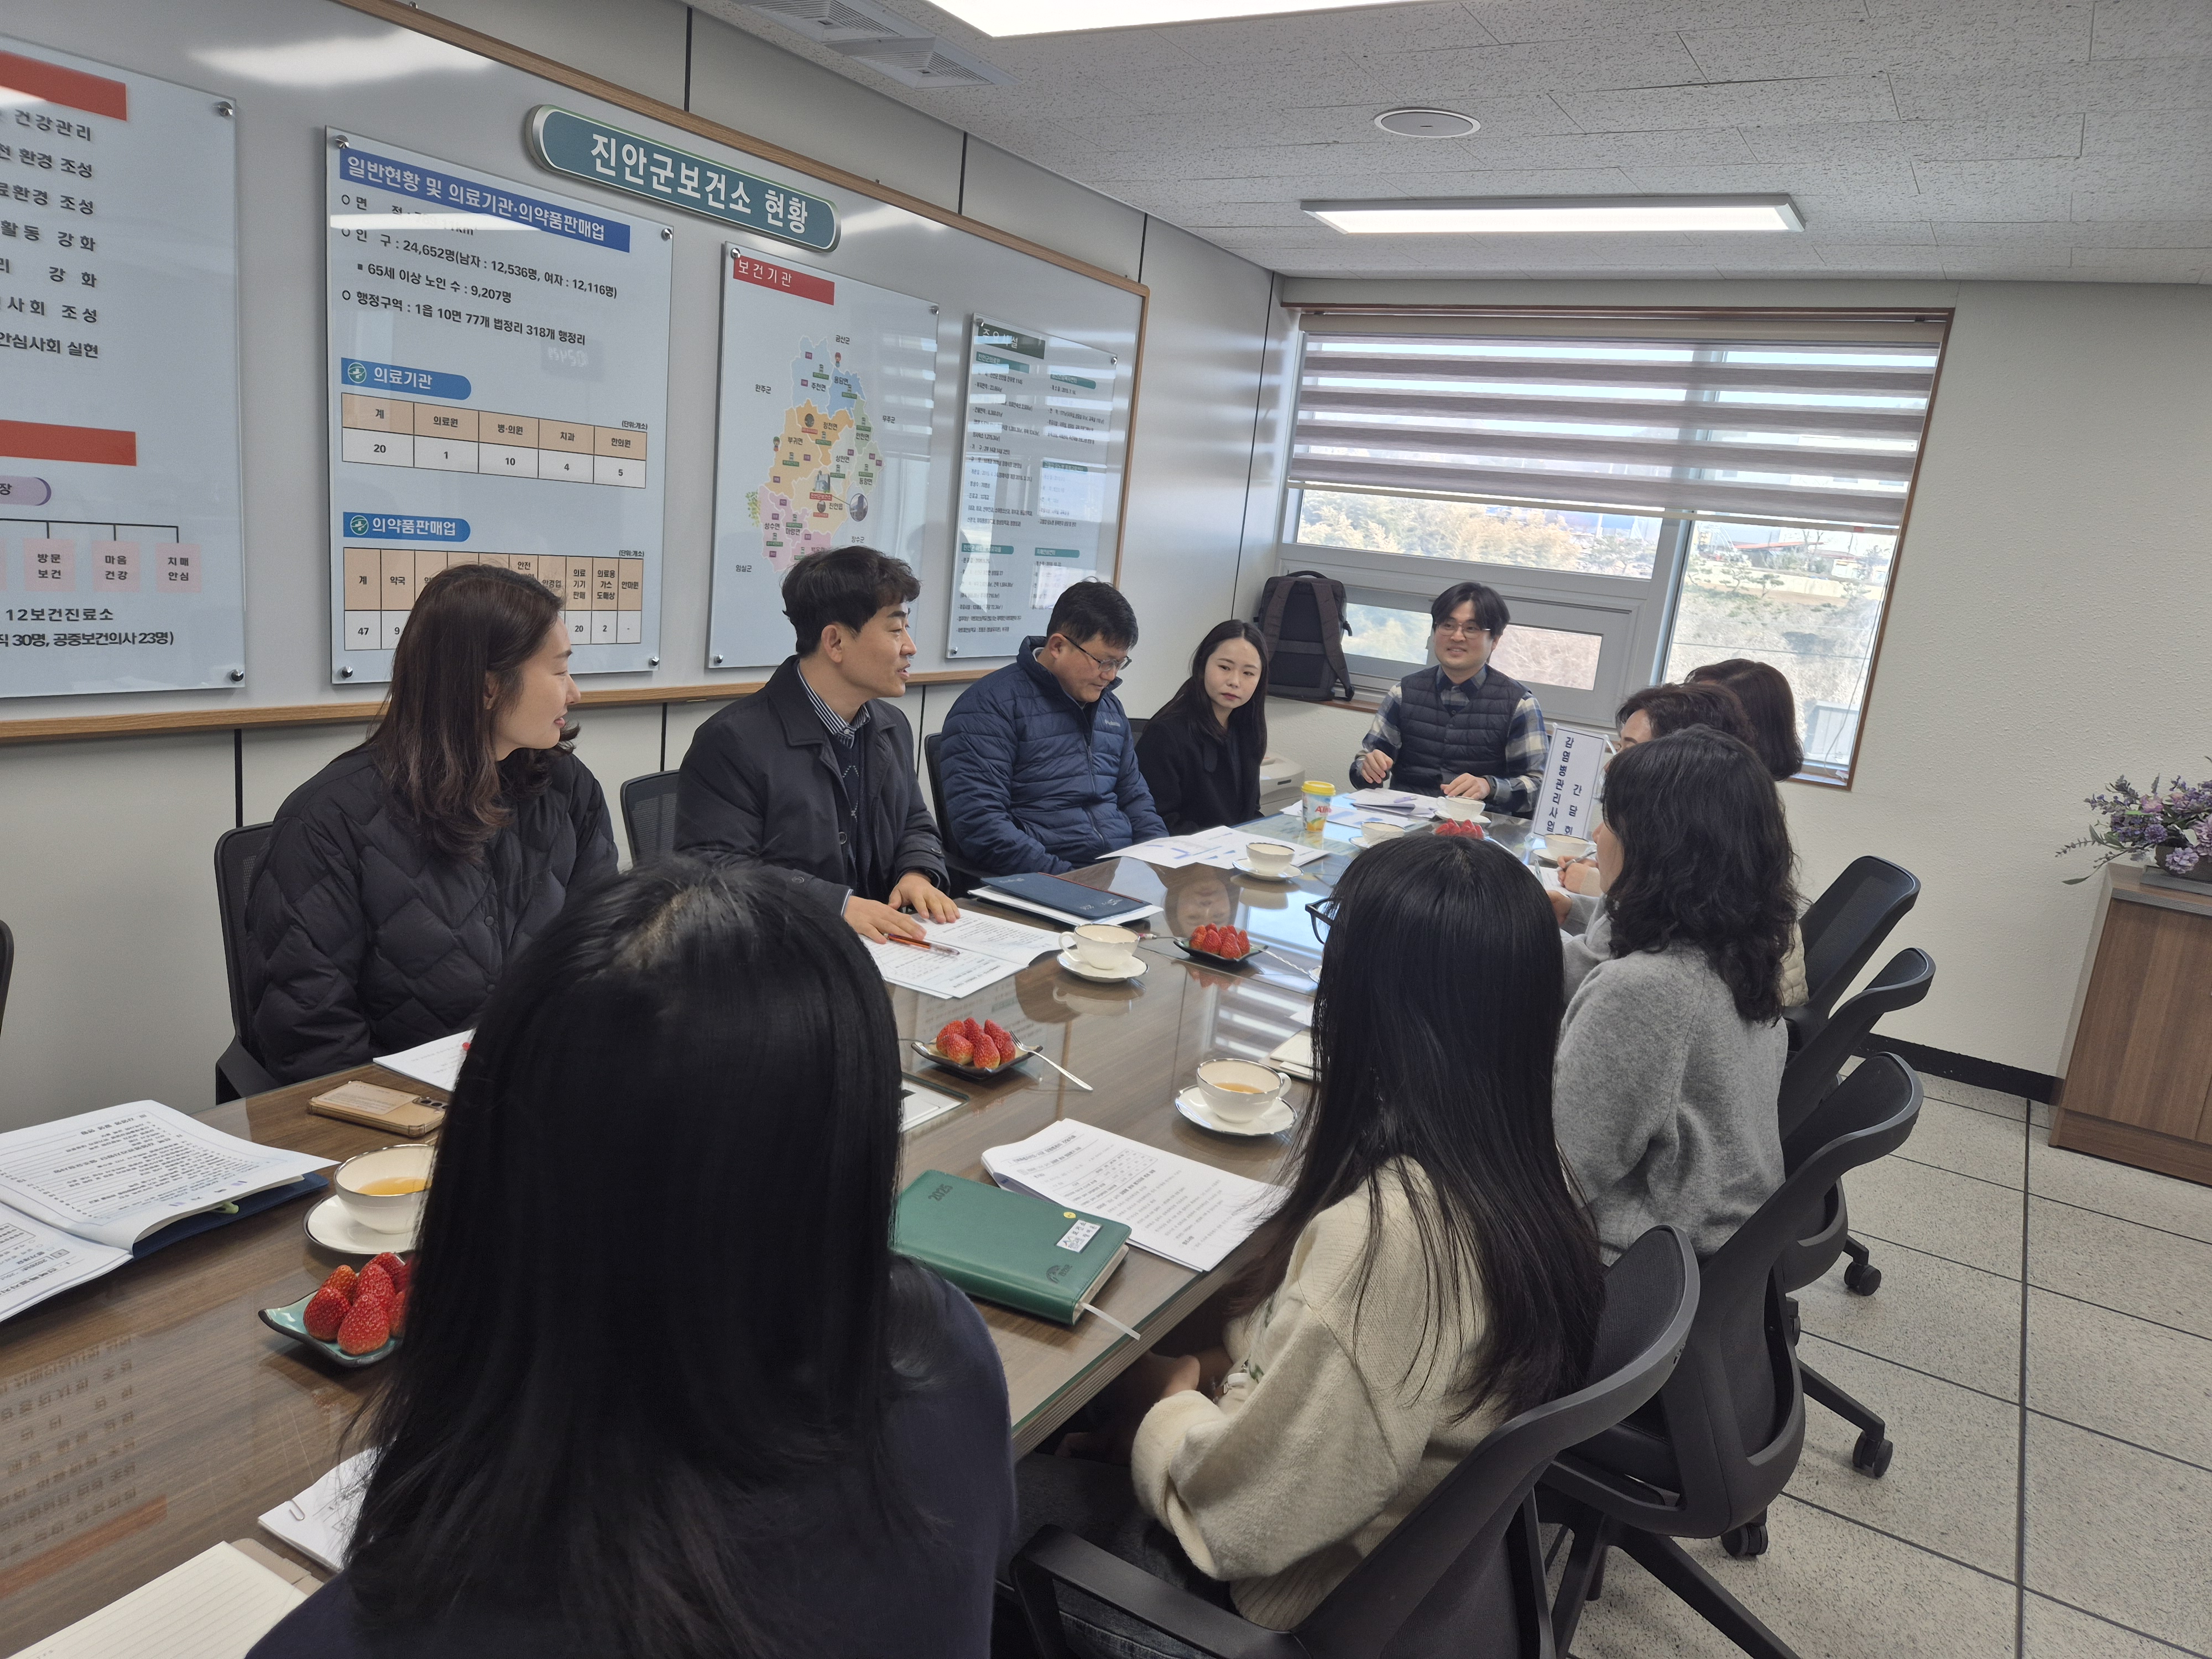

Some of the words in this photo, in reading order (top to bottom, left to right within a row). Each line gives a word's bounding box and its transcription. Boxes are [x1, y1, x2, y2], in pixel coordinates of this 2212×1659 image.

[15, 109, 91, 142] 건강관리
[19, 148, 53, 169] 환경
[60, 158, 92, 178] 조성
[591, 133, 752, 214] 진안군보건소
[764, 189, 808, 234] 현황
[347, 155, 420, 192] 일반현황
[426, 177, 441, 199] 및
[448, 184, 604, 242] 의료기관·의약품판매업
[60, 195, 93, 215] 조성
[1, 220, 39, 241] 활동
[58, 231, 95, 252] 강화
[738, 259, 792, 287] 보건기관
[367, 263, 395, 281] 65세
[399, 269, 421, 285] 이상
[425, 274, 447, 291] 노인
[450, 280, 461, 294] 수
[471, 284, 512, 304] 9,207명
[544, 272, 564, 287] 여자
[572, 279, 617, 299] 12,116명)
[7, 296, 44, 316] 사회
[62, 305, 97, 323] 조성
[357, 290, 403, 313] 행정구역
[415, 303, 432, 318] 1읍
[437, 307, 462, 323] 10면
[466, 312, 490, 328] 77개
[493, 317, 523, 335] 법정리
[526, 324, 555, 341] 318개
[558, 330, 586, 346] 행정리
[836, 335, 850, 345] 금산군
[67, 341, 98, 359] 실현
[374, 367, 432, 390] 의료기관
[755, 384, 771, 394] 완주군
[375, 409, 384, 420] 계
[433, 415, 458, 429] 의료원
[498, 424, 523, 436] 병·의원
[560, 431, 575, 442] 치과
[788, 437, 803, 445] 부귀면
[611, 437, 631, 448] 한의원
[373, 444, 387, 454] 20
[444, 451, 448, 460] 1
[505, 457, 515, 466] 10
[564, 463, 570, 471] 4
[372, 517, 456, 538] 의약품판매업
[37, 554, 61, 564] 방문
[105, 555, 127, 565] 마음
[168, 557, 189, 566] 치매
[518, 561, 531, 570] 안전
[38, 570, 61, 579] 보건
[105, 571, 128, 580] 건강
[168, 572, 189, 581] 안심
[573, 569, 586, 577] 의료
[597, 569, 615, 578] 의료용
[358, 575, 368, 586] 계
[390, 575, 406, 586] 약국
[573, 581, 586, 589] 기기
[600, 581, 613, 589] 가스
[622, 581, 639, 589] 안마원
[573, 592, 586, 600] 판매
[357, 627, 369, 637] 47
[12, 634, 50, 648] 30명,
[53, 632, 137, 646] 공중보건의사
[138, 632, 175, 645] 23명)
[1547, 737, 1574, 833] 감염병관리사업
[1564, 784, 1582, 835] 간담회
[928, 1184, 953, 1201] 2025
